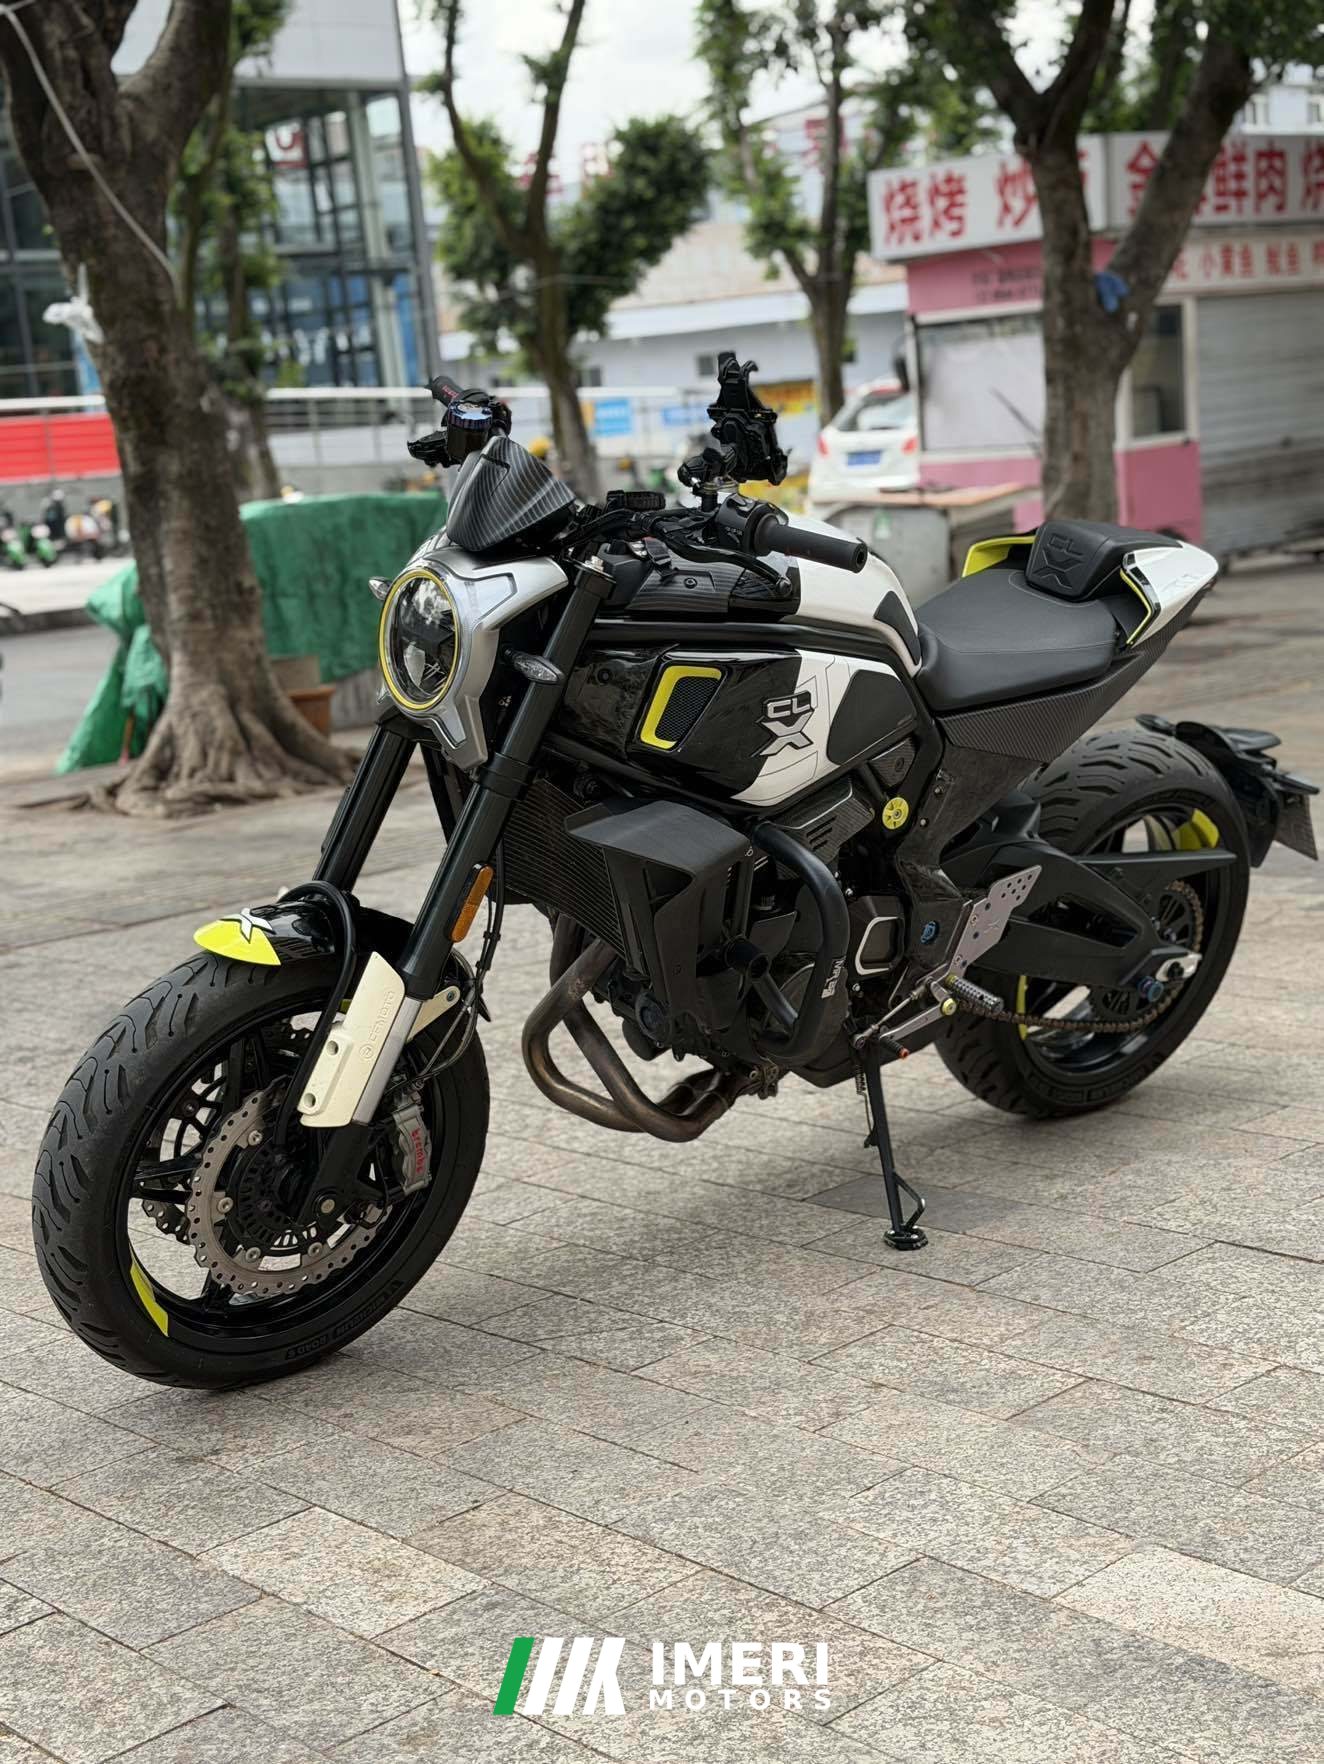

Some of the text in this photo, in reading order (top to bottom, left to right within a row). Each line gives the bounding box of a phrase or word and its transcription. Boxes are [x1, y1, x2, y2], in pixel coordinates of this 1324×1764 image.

[883, 170, 967, 244] 烧烤
[766, 696, 812, 719] CL
[759, 710, 815, 756] X
